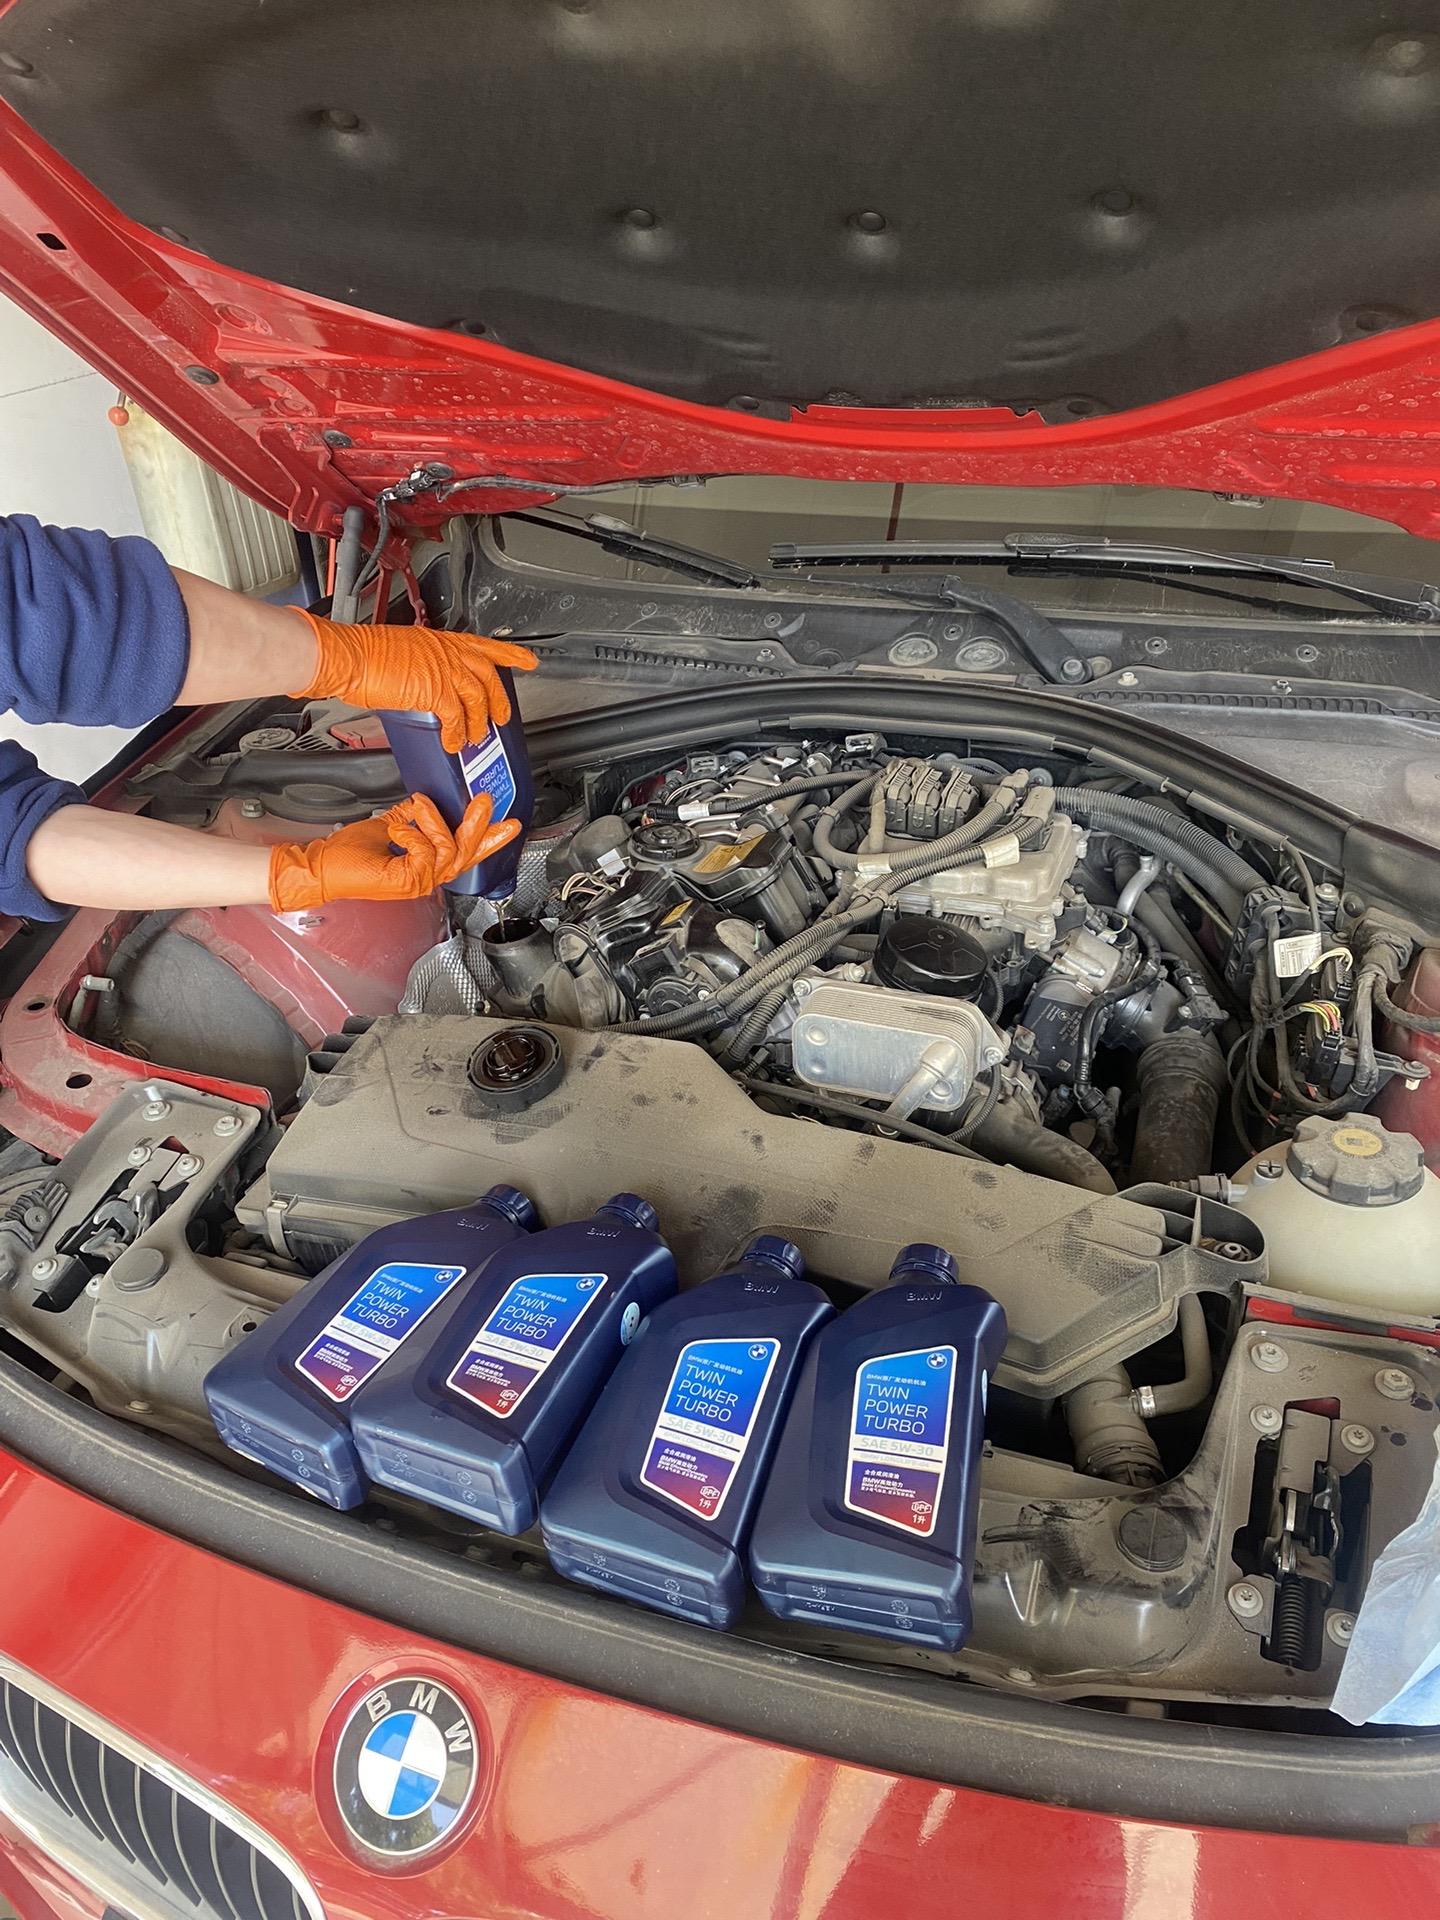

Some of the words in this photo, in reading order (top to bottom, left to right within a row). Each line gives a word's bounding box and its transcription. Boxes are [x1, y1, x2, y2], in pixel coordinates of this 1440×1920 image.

[479, 761, 504, 788] TURBO
[484, 769, 507, 794] POWE
[373, 1280, 407, 1301] TWIN
[361, 1292, 410, 1318] POWER
[513, 1293, 550, 1312] TWIN
[352, 1303, 398, 1329] TURBO
[503, 1305, 557, 1328] POWER
[496, 1317, 547, 1340] TURBO
[686, 1364, 726, 1386] TWIN
[678, 1379, 739, 1407] POWER
[866, 1383, 910, 1400] TWIN
[675, 1394, 732, 1422] TURBO
[864, 1398, 929, 1419] POWER
[667, 1417, 693, 1431] SAE
[694, 1424, 735, 1444] 5W-30
[864, 1414, 925, 1435] TURBO
[860, 1438, 888, 1449] SAE
[890, 1441, 934, 1456] 5W-30
[698, 1498, 711, 1509] 1升
[912, 1514, 926, 1524] 1升
[366, 1683, 472, 1753] BMW
